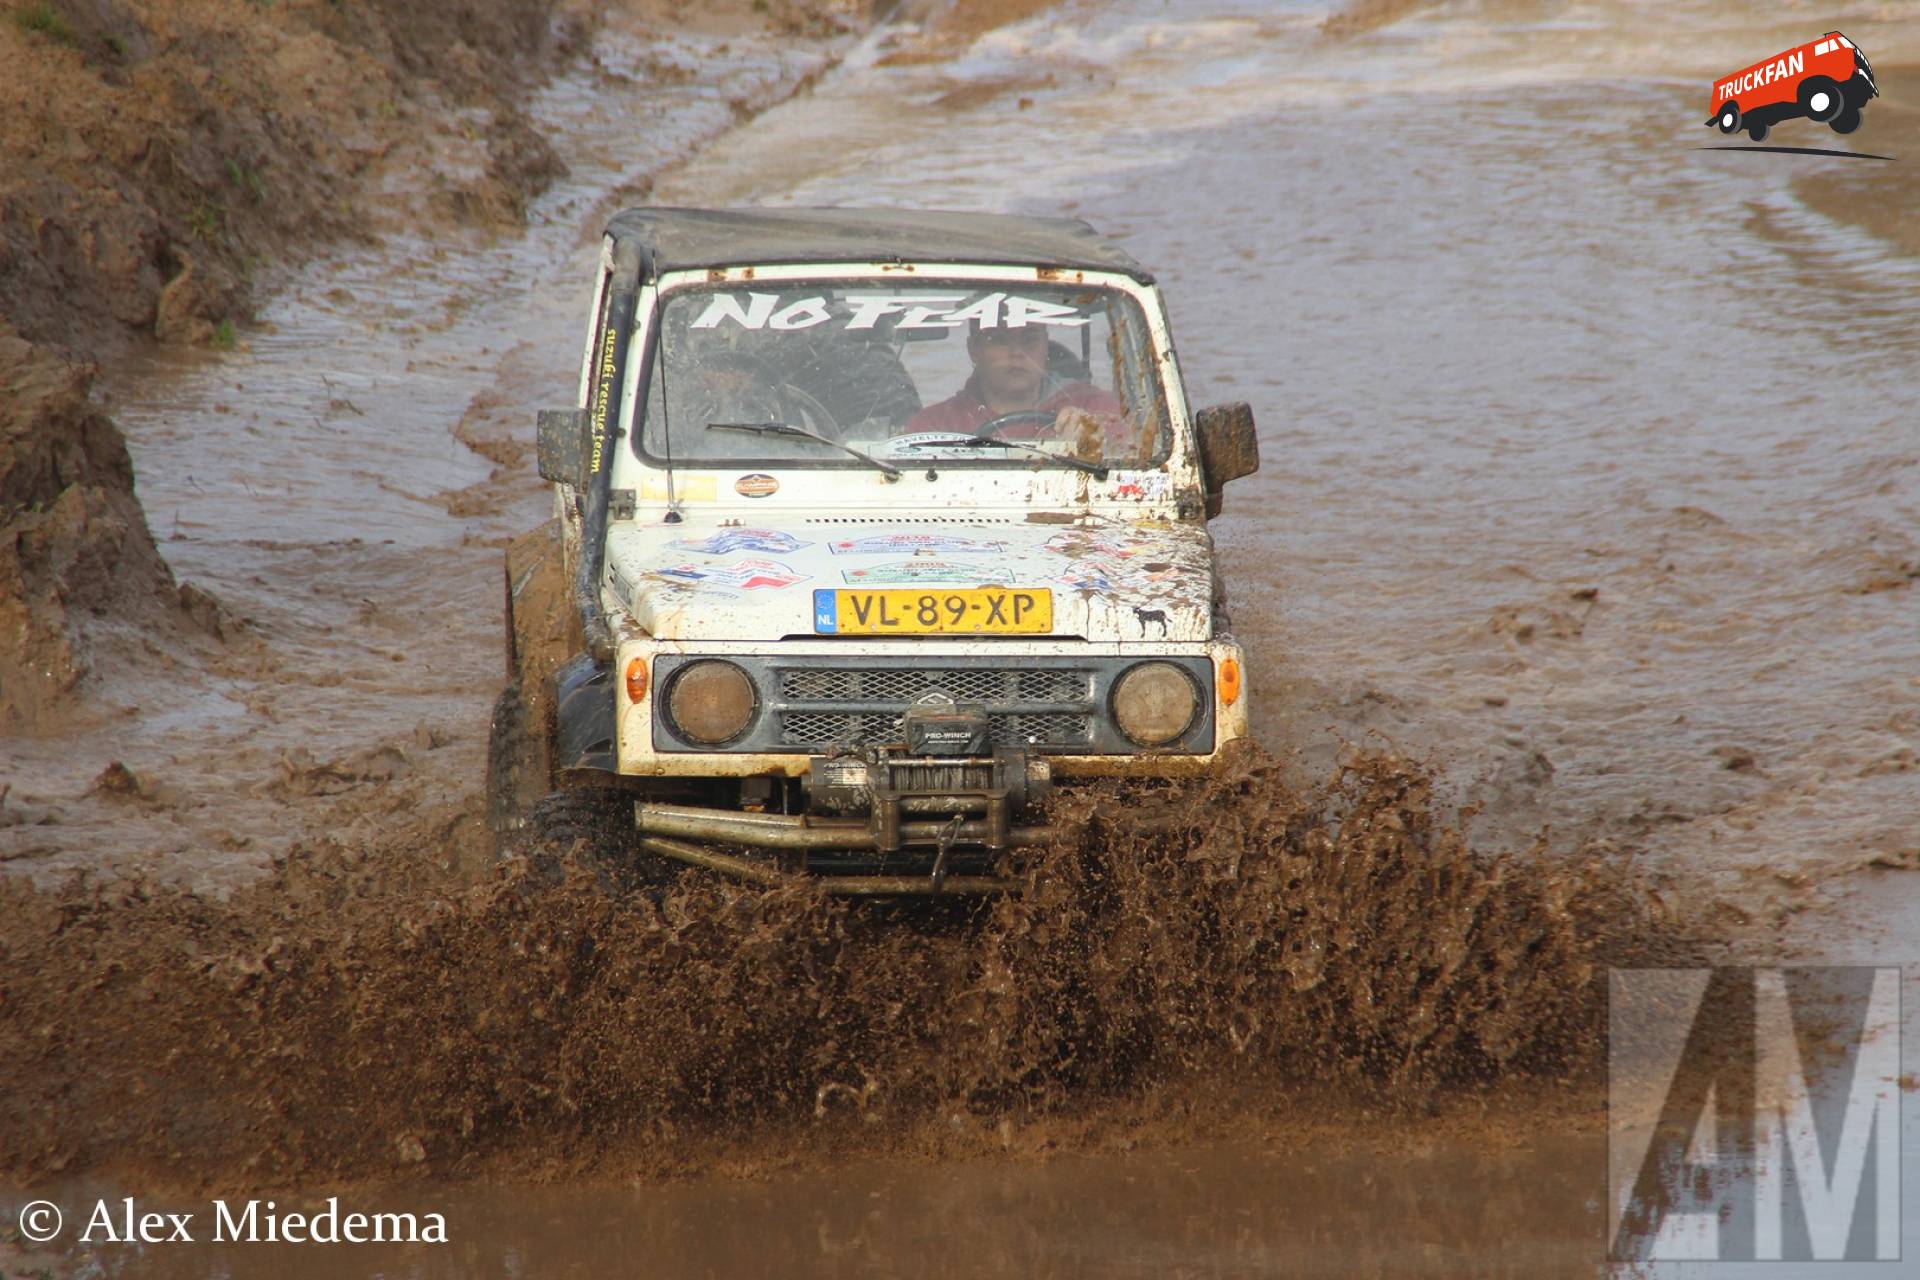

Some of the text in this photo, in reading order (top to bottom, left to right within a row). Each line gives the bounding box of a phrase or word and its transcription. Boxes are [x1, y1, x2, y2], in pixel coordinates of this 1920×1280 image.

[690, 291, 1092, 330] NO FEAR
[596, 381, 610, 431] rescue
[590, 433, 606, 474] team
[817, 593, 1036, 627] NL VL-89-XP
[924, 731, 972, 739] PRO-WINCH
